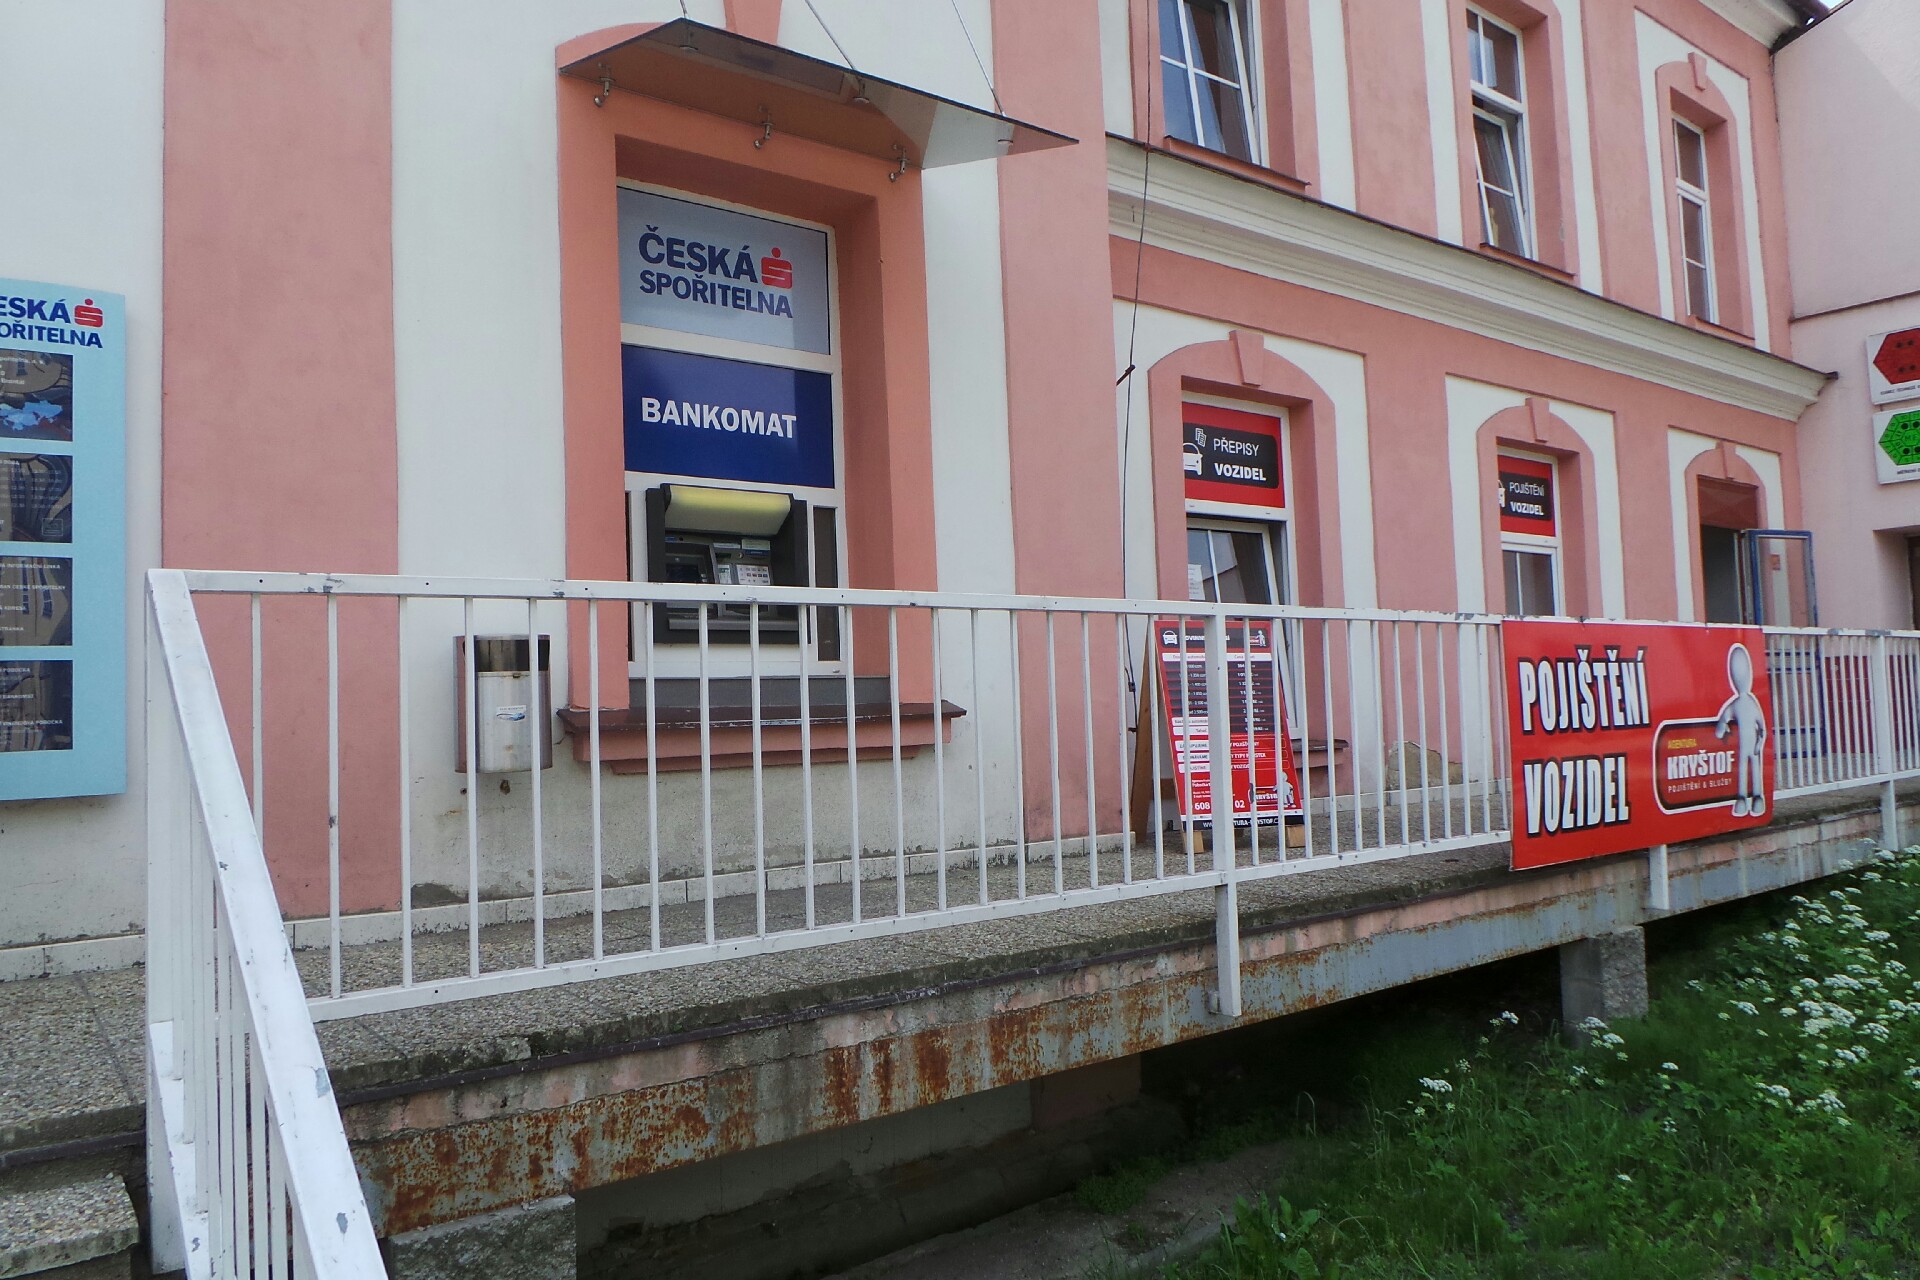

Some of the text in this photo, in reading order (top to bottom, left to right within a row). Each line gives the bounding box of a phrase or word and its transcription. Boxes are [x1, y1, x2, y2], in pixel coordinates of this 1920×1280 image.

[638, 224, 758, 283] ČESKÁ
[639, 269, 793, 318] SPOŘITELNA
[0, 295, 71, 324] ESKÁ
[0, 319, 103, 348] OŘITELNA
[641, 397, 797, 438] BANKOMAT
[1213, 437, 1259, 456] PŘEPISY
[1214, 462, 1266, 481] VOZIDEL
[1509, 482, 1545, 497] POJIŠTĚNÍ
[1510, 501, 1545, 516] VOZIDEL
[1519, 649, 1650, 731] POJIŠTĚNÍ
[1667, 749, 1735, 780] KRYŠTOF
[1194, 802, 1211, 810] 608
[1234, 800, 1246, 809] 02
[1523, 756, 1630, 834] VOZIDEL
